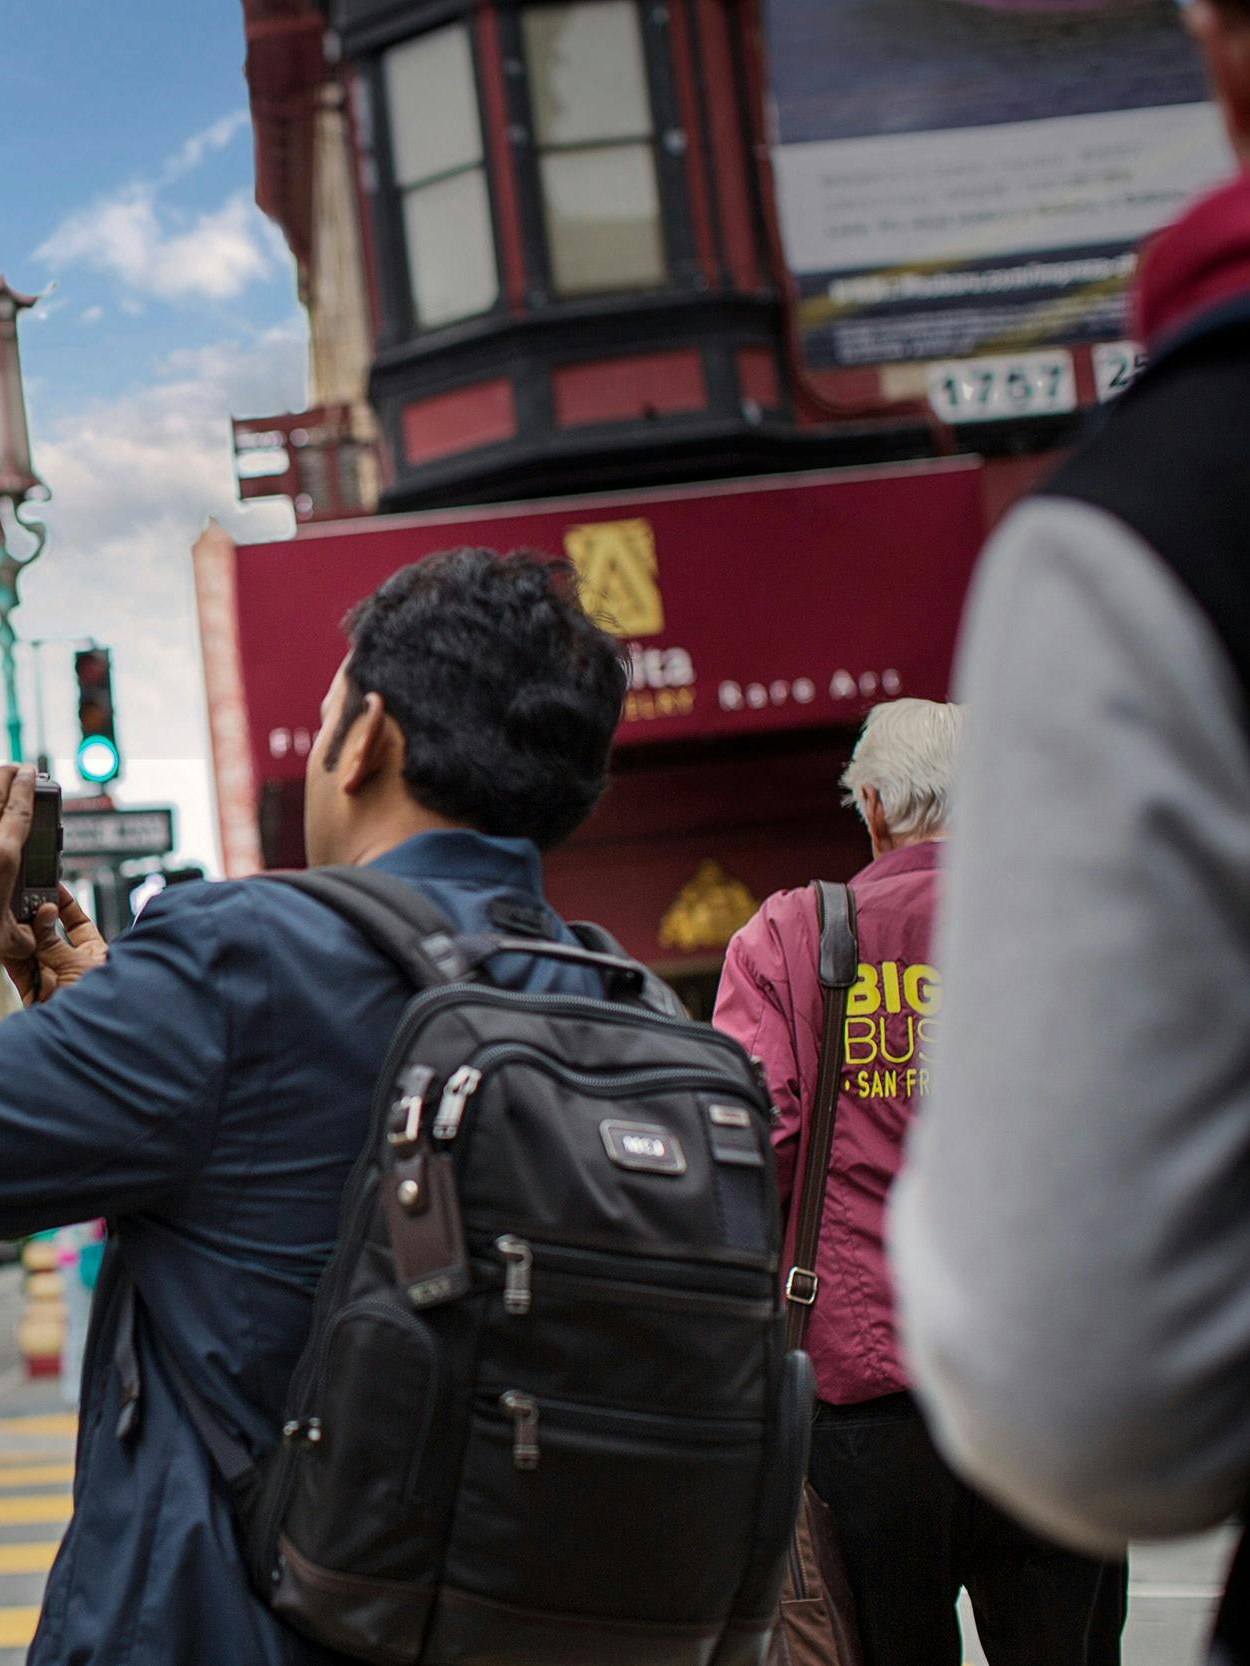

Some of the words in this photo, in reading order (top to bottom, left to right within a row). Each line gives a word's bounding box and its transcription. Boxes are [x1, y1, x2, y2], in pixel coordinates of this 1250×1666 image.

[626, 641, 696, 689] ita
[846, 961, 943, 1016] BIG
[857, 1070, 897, 1098] SAN
[906, 1068, 935, 1097] FR
